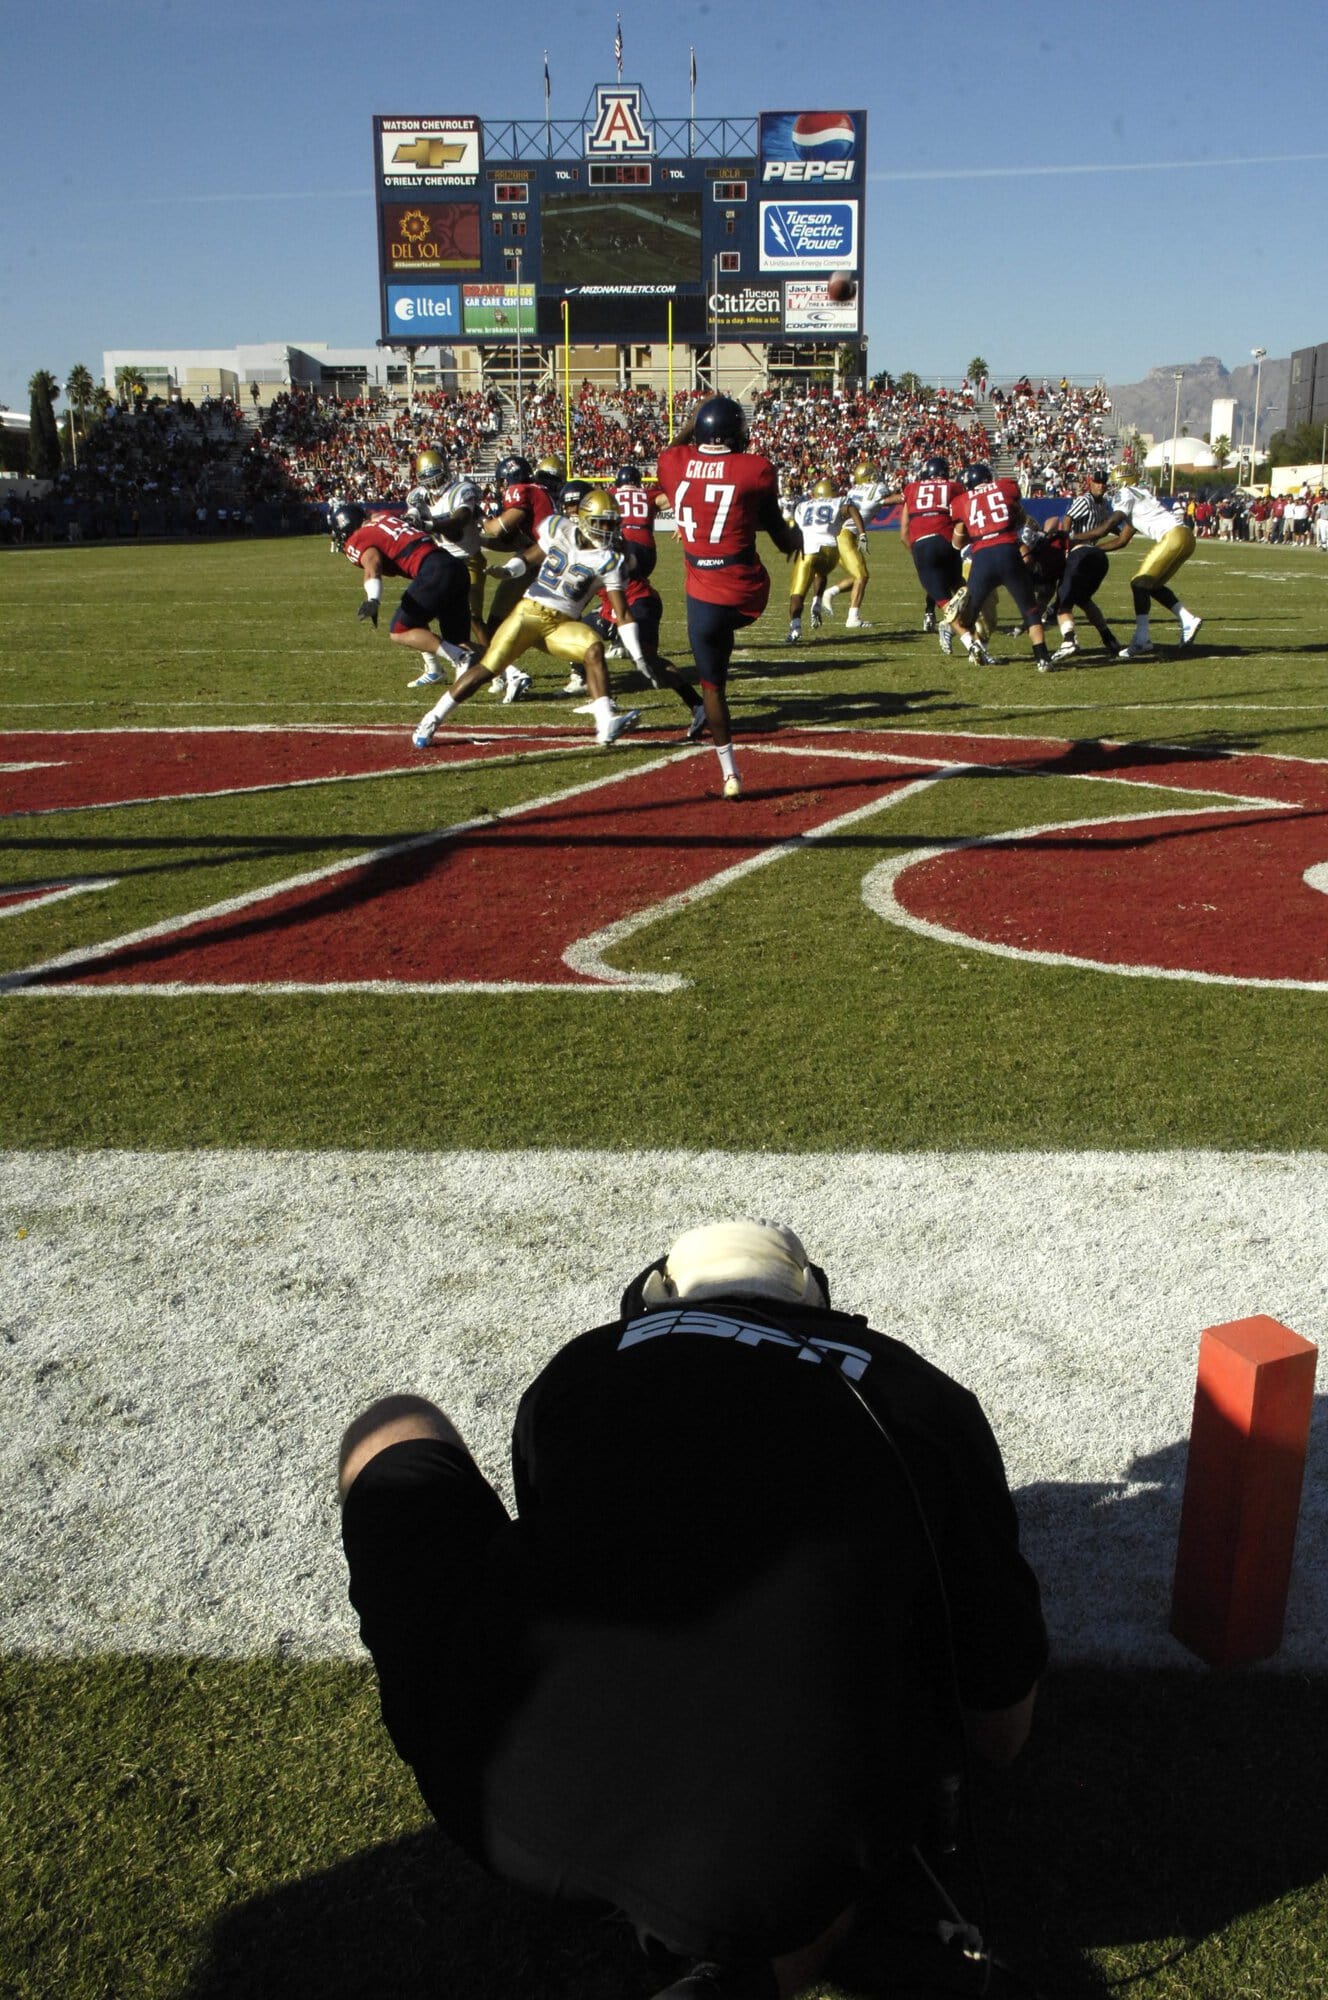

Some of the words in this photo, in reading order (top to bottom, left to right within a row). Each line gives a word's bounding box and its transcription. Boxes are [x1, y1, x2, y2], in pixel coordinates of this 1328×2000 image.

[383, 121, 420, 130] WATSON
[422, 121, 474, 130] CHEVROLET
[586, 90, 652, 155] A
[556, 171, 571, 180] TOL
[670, 170, 685, 178] TOL
[762, 161, 855, 182] PEPSI
[385, 177, 423, 186] O'RIELLY
[425, 176, 476, 186] CHEVROLET
[786, 211, 832, 225] Tucson
[791, 224, 844, 237] Electric
[392, 244, 413, 258] DEL
[418, 243, 440, 258] SOL
[796, 237, 843, 250] Power
[463, 286, 504, 296] BRAKE
[579, 285, 676, 294] ARIZONAATHLETICS.COM
[743, 288, 780, 298] Tucson
[788, 285, 812, 293] Jack
[394, 297, 452, 321] alltel
[465, 298, 480, 307] CAR
[482, 298, 501, 307] CARE
[708, 294, 781, 313] Citizen
[685, 460, 725, 479] CRIER
[504, 488, 521, 503] 44
[916, 484, 948, 509] 51
[615, 492, 649, 518] 55
[675, 481, 736, 543] 47
[969, 492, 1010, 529] 45
[537, 545, 596, 602] 23
[617, 1310, 872, 1381] ESPN
